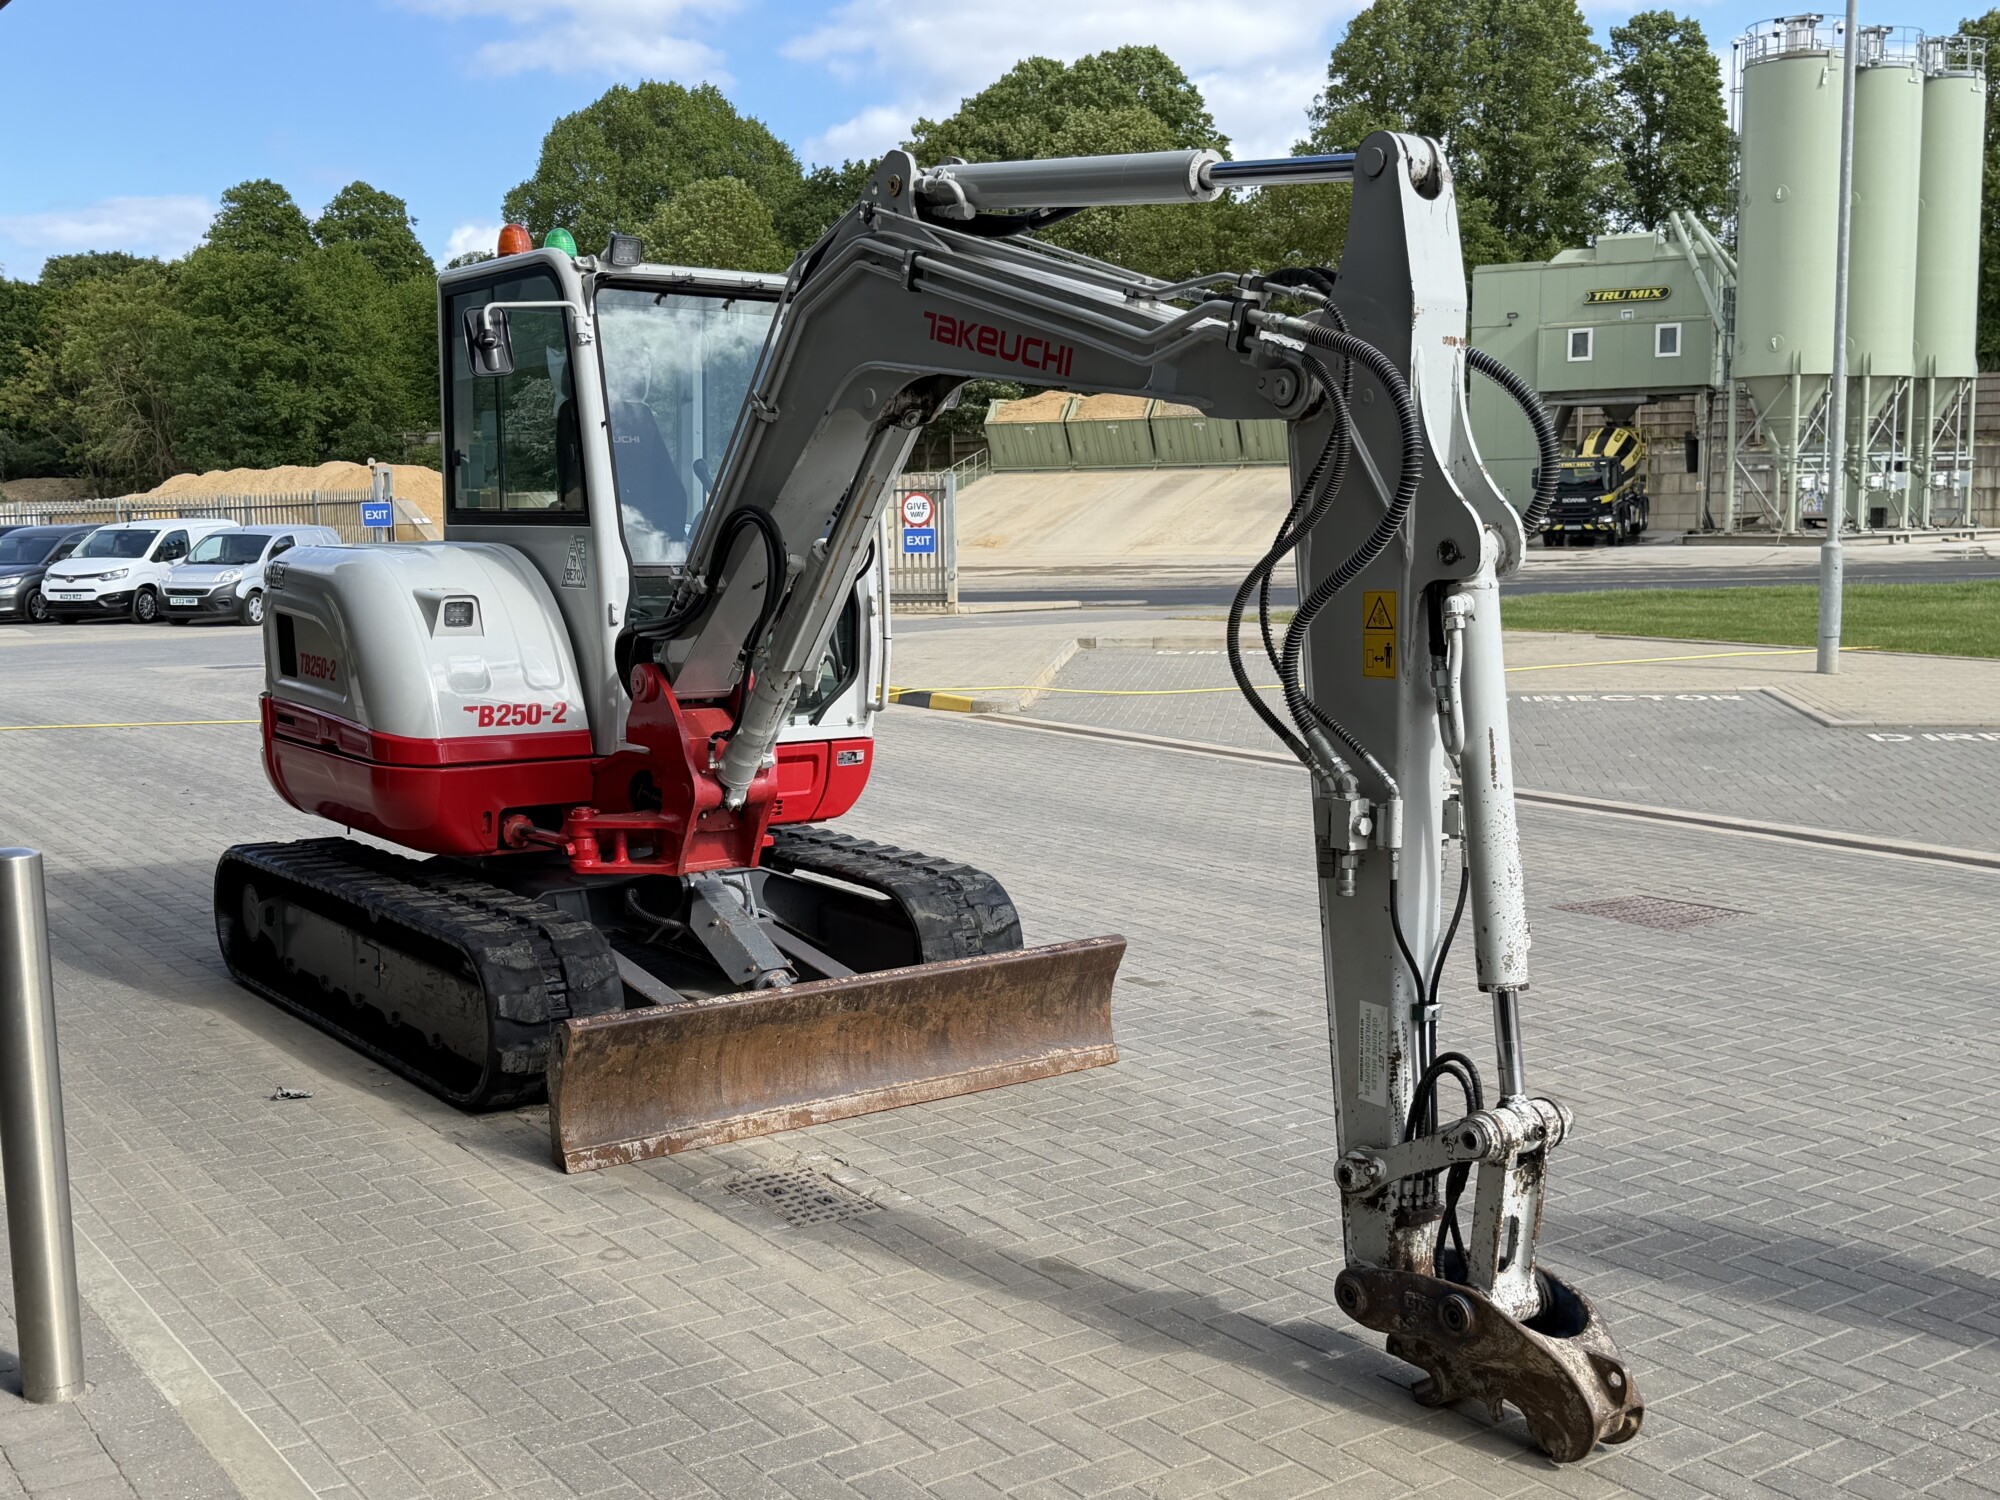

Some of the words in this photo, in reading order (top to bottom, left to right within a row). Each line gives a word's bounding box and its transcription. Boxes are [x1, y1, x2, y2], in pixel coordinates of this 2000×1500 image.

[1593, 291, 1627, 301] TRU
[1628, 288, 1663, 299] MIX
[906, 502, 928, 510] GIVE
[365, 510, 388, 520] EXIT
[906, 535, 932, 546] EXIT
[300, 652, 337, 682] TB250-2
[1520, 694, 1744, 702] IRECTOR
